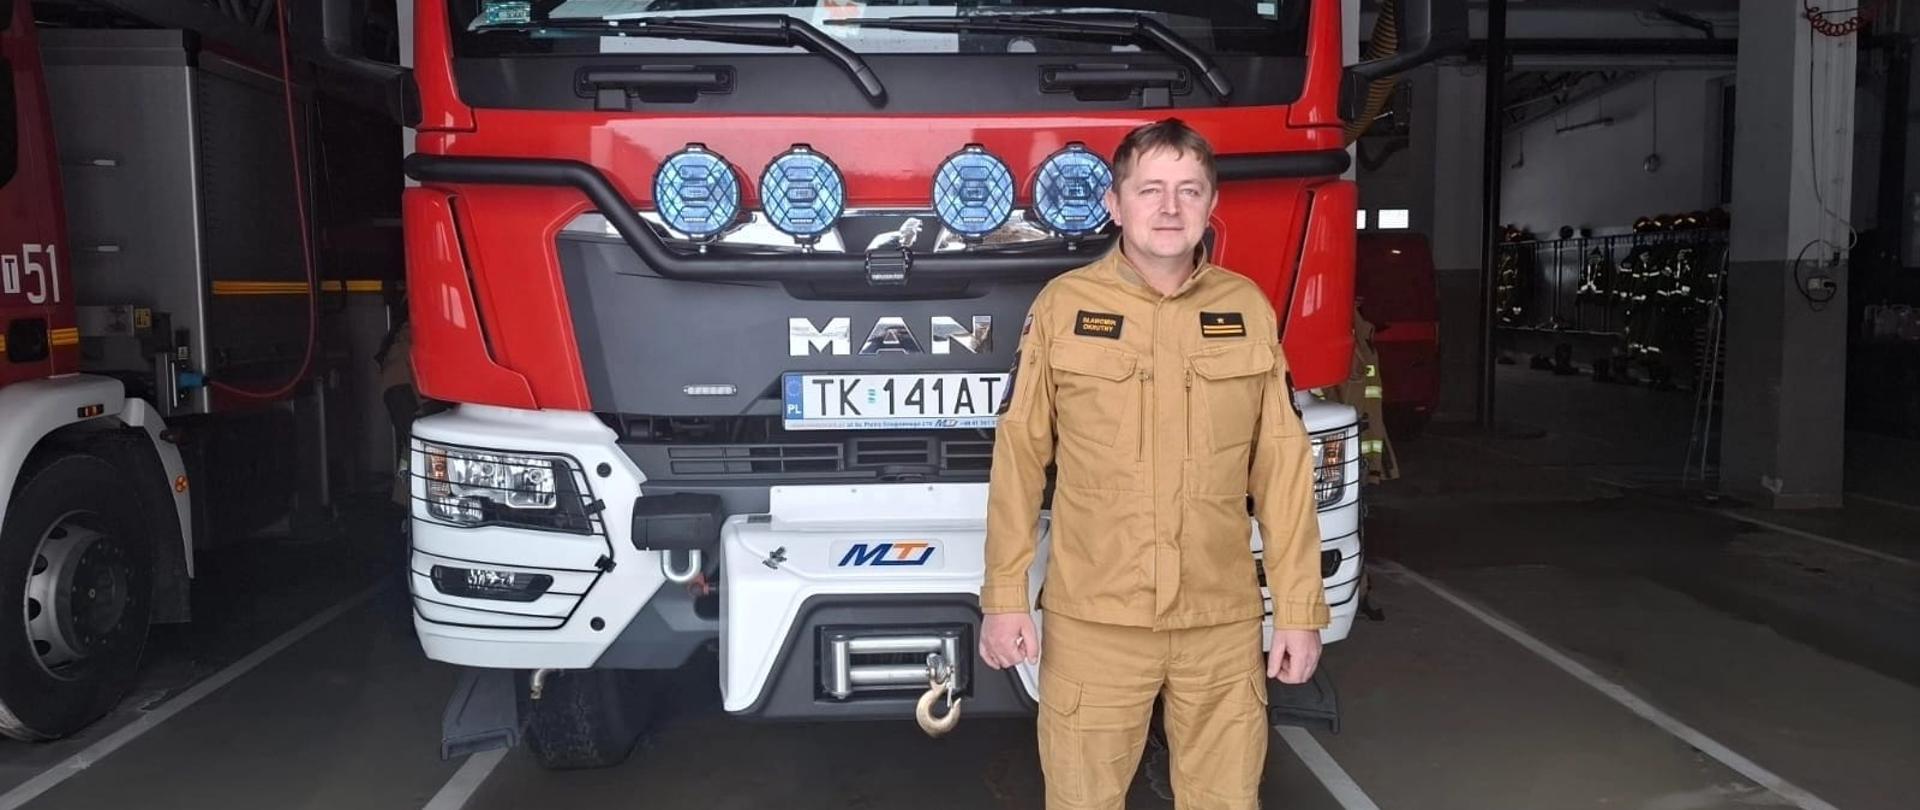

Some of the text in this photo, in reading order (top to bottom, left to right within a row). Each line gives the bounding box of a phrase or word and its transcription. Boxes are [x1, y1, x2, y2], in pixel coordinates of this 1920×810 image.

[22, 243, 61, 304] 51
[789, 315, 993, 356] MAN
[787, 403, 801, 415] PL
[812, 377, 1001, 416] TK 141AT
